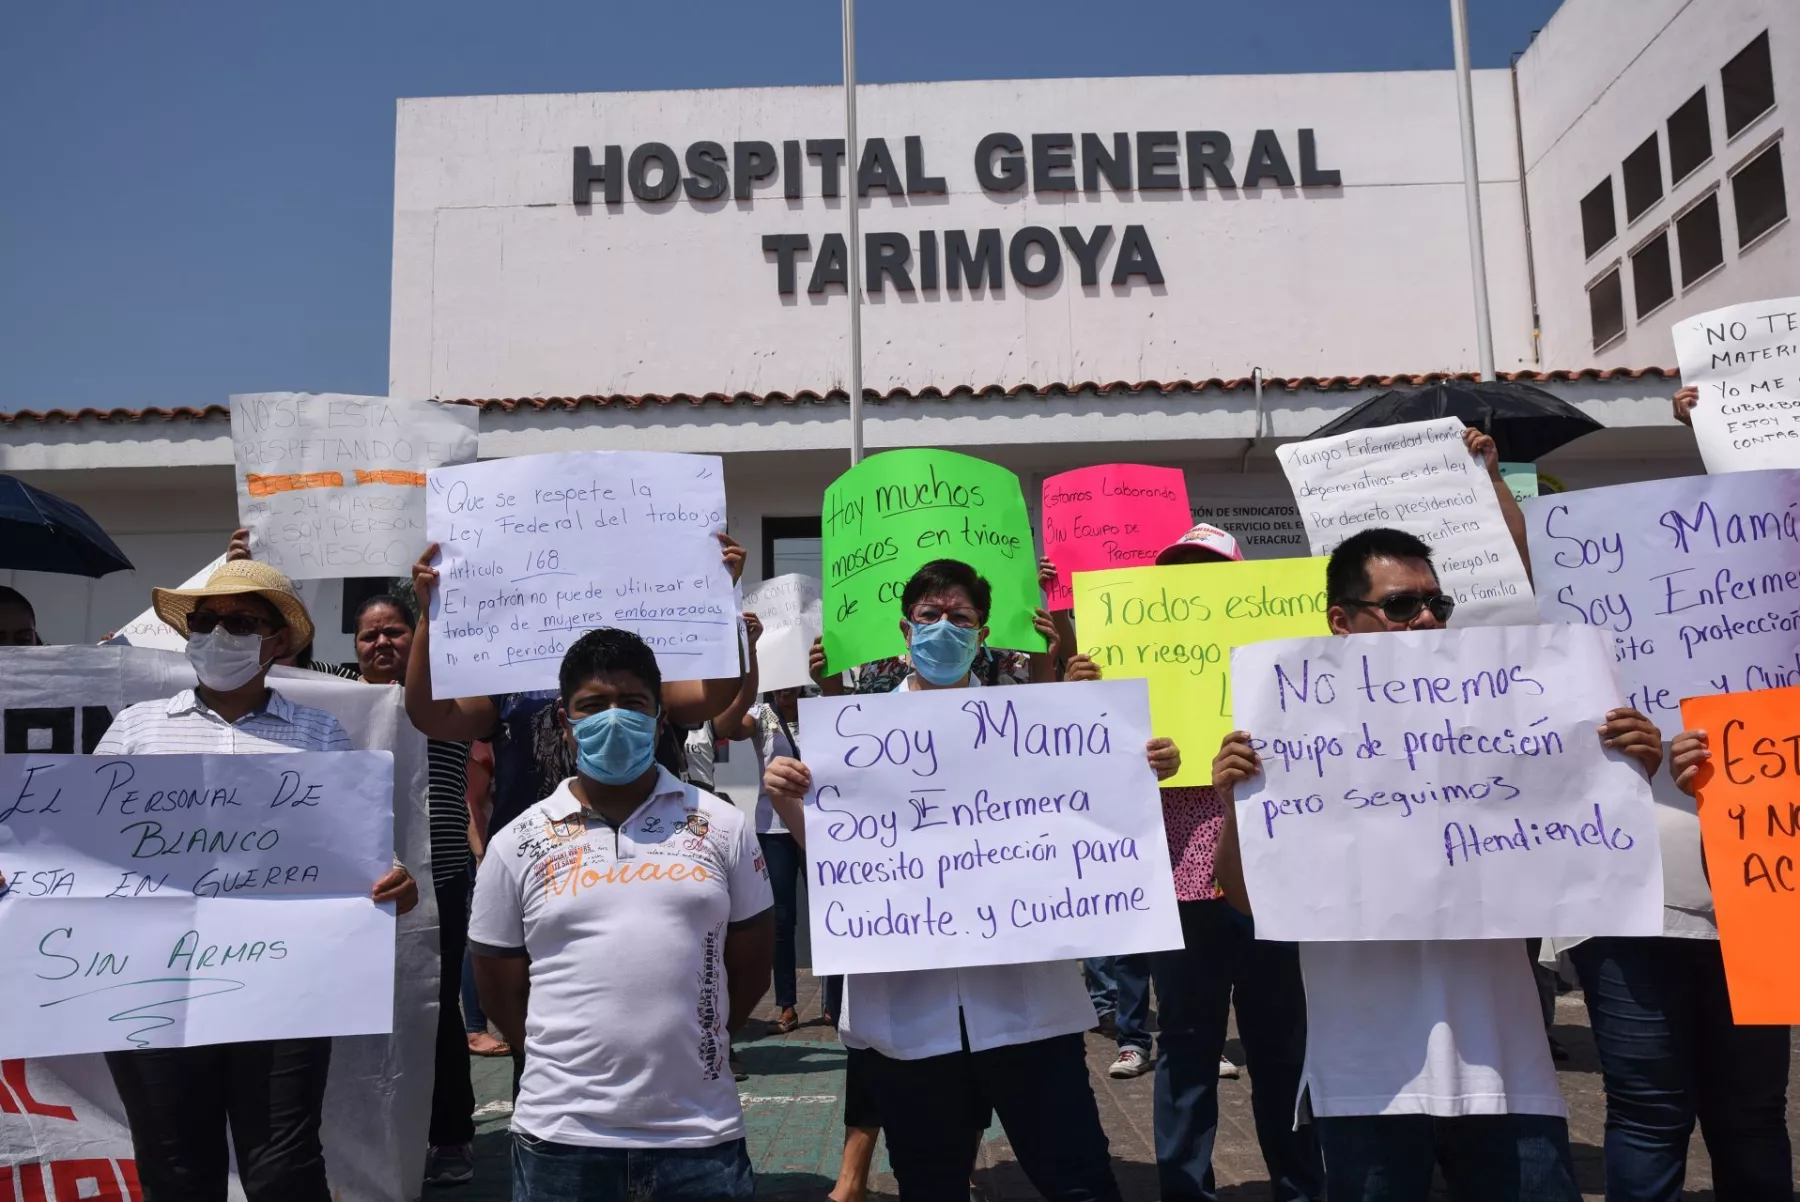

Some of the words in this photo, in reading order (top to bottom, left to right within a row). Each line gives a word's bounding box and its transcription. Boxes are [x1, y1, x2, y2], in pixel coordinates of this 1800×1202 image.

[572, 134, 947, 205] HOSPITAL
[974, 127, 1343, 194] GENERAL
[761, 223, 1166, 297] TARIMOYA
[1711, 345, 1798, 370] MATERI
[1712, 381, 1740, 399] YO
[1750, 378, 1784, 394] ME
[327, 401, 400, 429] ESTA
[240, 438, 413, 464] RESPETANDO
[1422, 463, 1440, 476] de
[1443, 453, 1467, 475] ley
[495, 493, 516, 508] se
[535, 479, 618, 514] respete
[826, 488, 864, 537] Hay
[875, 463, 985, 513] muchos
[1043, 484, 1093, 508] Estamos
[1102, 477, 1176, 501] Laborando
[1310, 511, 1334, 529] Por
[1338, 502, 1390, 526] decreto
[1394, 487, 1478, 521] presidencial
[449, 523, 484, 549] Ley
[494, 511, 584, 535] Federal
[594, 507, 628, 528] del
[1125, 524, 1139, 533] DE
[1216, 507, 1230, 516] DE
[1232, 506, 1294, 517] SINDICATOS
[1223, 521, 1272, 532] SERVICIO
[1276, 521, 1293, 531] DEL
[281, 519, 322, 542] SOY
[831, 536, 900, 579] moscos
[916, 528, 951, 549] en
[961, 515, 1021, 559] triage
[1245, 534, 1301, 545] VERACRUZ
[1545, 505, 1625, 573] Soy
[1659, 500, 1799, 554] Mamá
[292, 540, 412, 568] RIESGO
[525, 549, 561, 572] 168
[1442, 557, 1483, 575] riezgo
[1484, 549, 1499, 563] la
[530, 592, 548, 606] no
[555, 582, 604, 609] puede
[693, 575, 710, 591] el
[836, 593, 859, 623] de
[1453, 587, 1468, 604] la
[1470, 579, 1517, 601] familia
[509, 617, 530, 633] de
[614, 601, 724, 620] embarazadas
[472, 650, 491, 663] en
[506, 637, 566, 668] periodo
[1087, 643, 1124, 668] en
[1136, 641, 1221, 676] riesgo
[1274, 659, 1336, 712] No
[1356, 655, 1545, 704] tenemos
[836, 703, 938, 777] Soy
[962, 700, 1110, 758] Mamá
[1248, 733, 1343, 777] equipo
[1355, 722, 1386, 760] de
[1403, 716, 1564, 770] protección
[0, 764, 61, 821] EL
[95, 761, 242, 815] PERSONAL
[270, 770, 323, 809] DE
[816, 785, 897, 848] Soy
[908, 789, 1090, 832] Enfermera
[1262, 794, 1325, 838] pero
[1728, 804, 1746, 841] Y
[120, 821, 279, 858] BLANCO
[1443, 803, 1634, 866] Atendiendo
[544, 848, 712, 902] Monaco
[816, 852, 924, 886] necesito
[938, 833, 1057, 888] protección
[1071, 836, 1139, 879] para
[1743, 853, 1796, 893] AC
[6, 868, 76, 897] ESTA
[105, 872, 170, 898] EN
[192, 865, 318, 899] GUERRA
[977, 907, 997, 939] y
[35, 927, 129, 980] SIN
[167, 931, 288, 970] ARMAS
